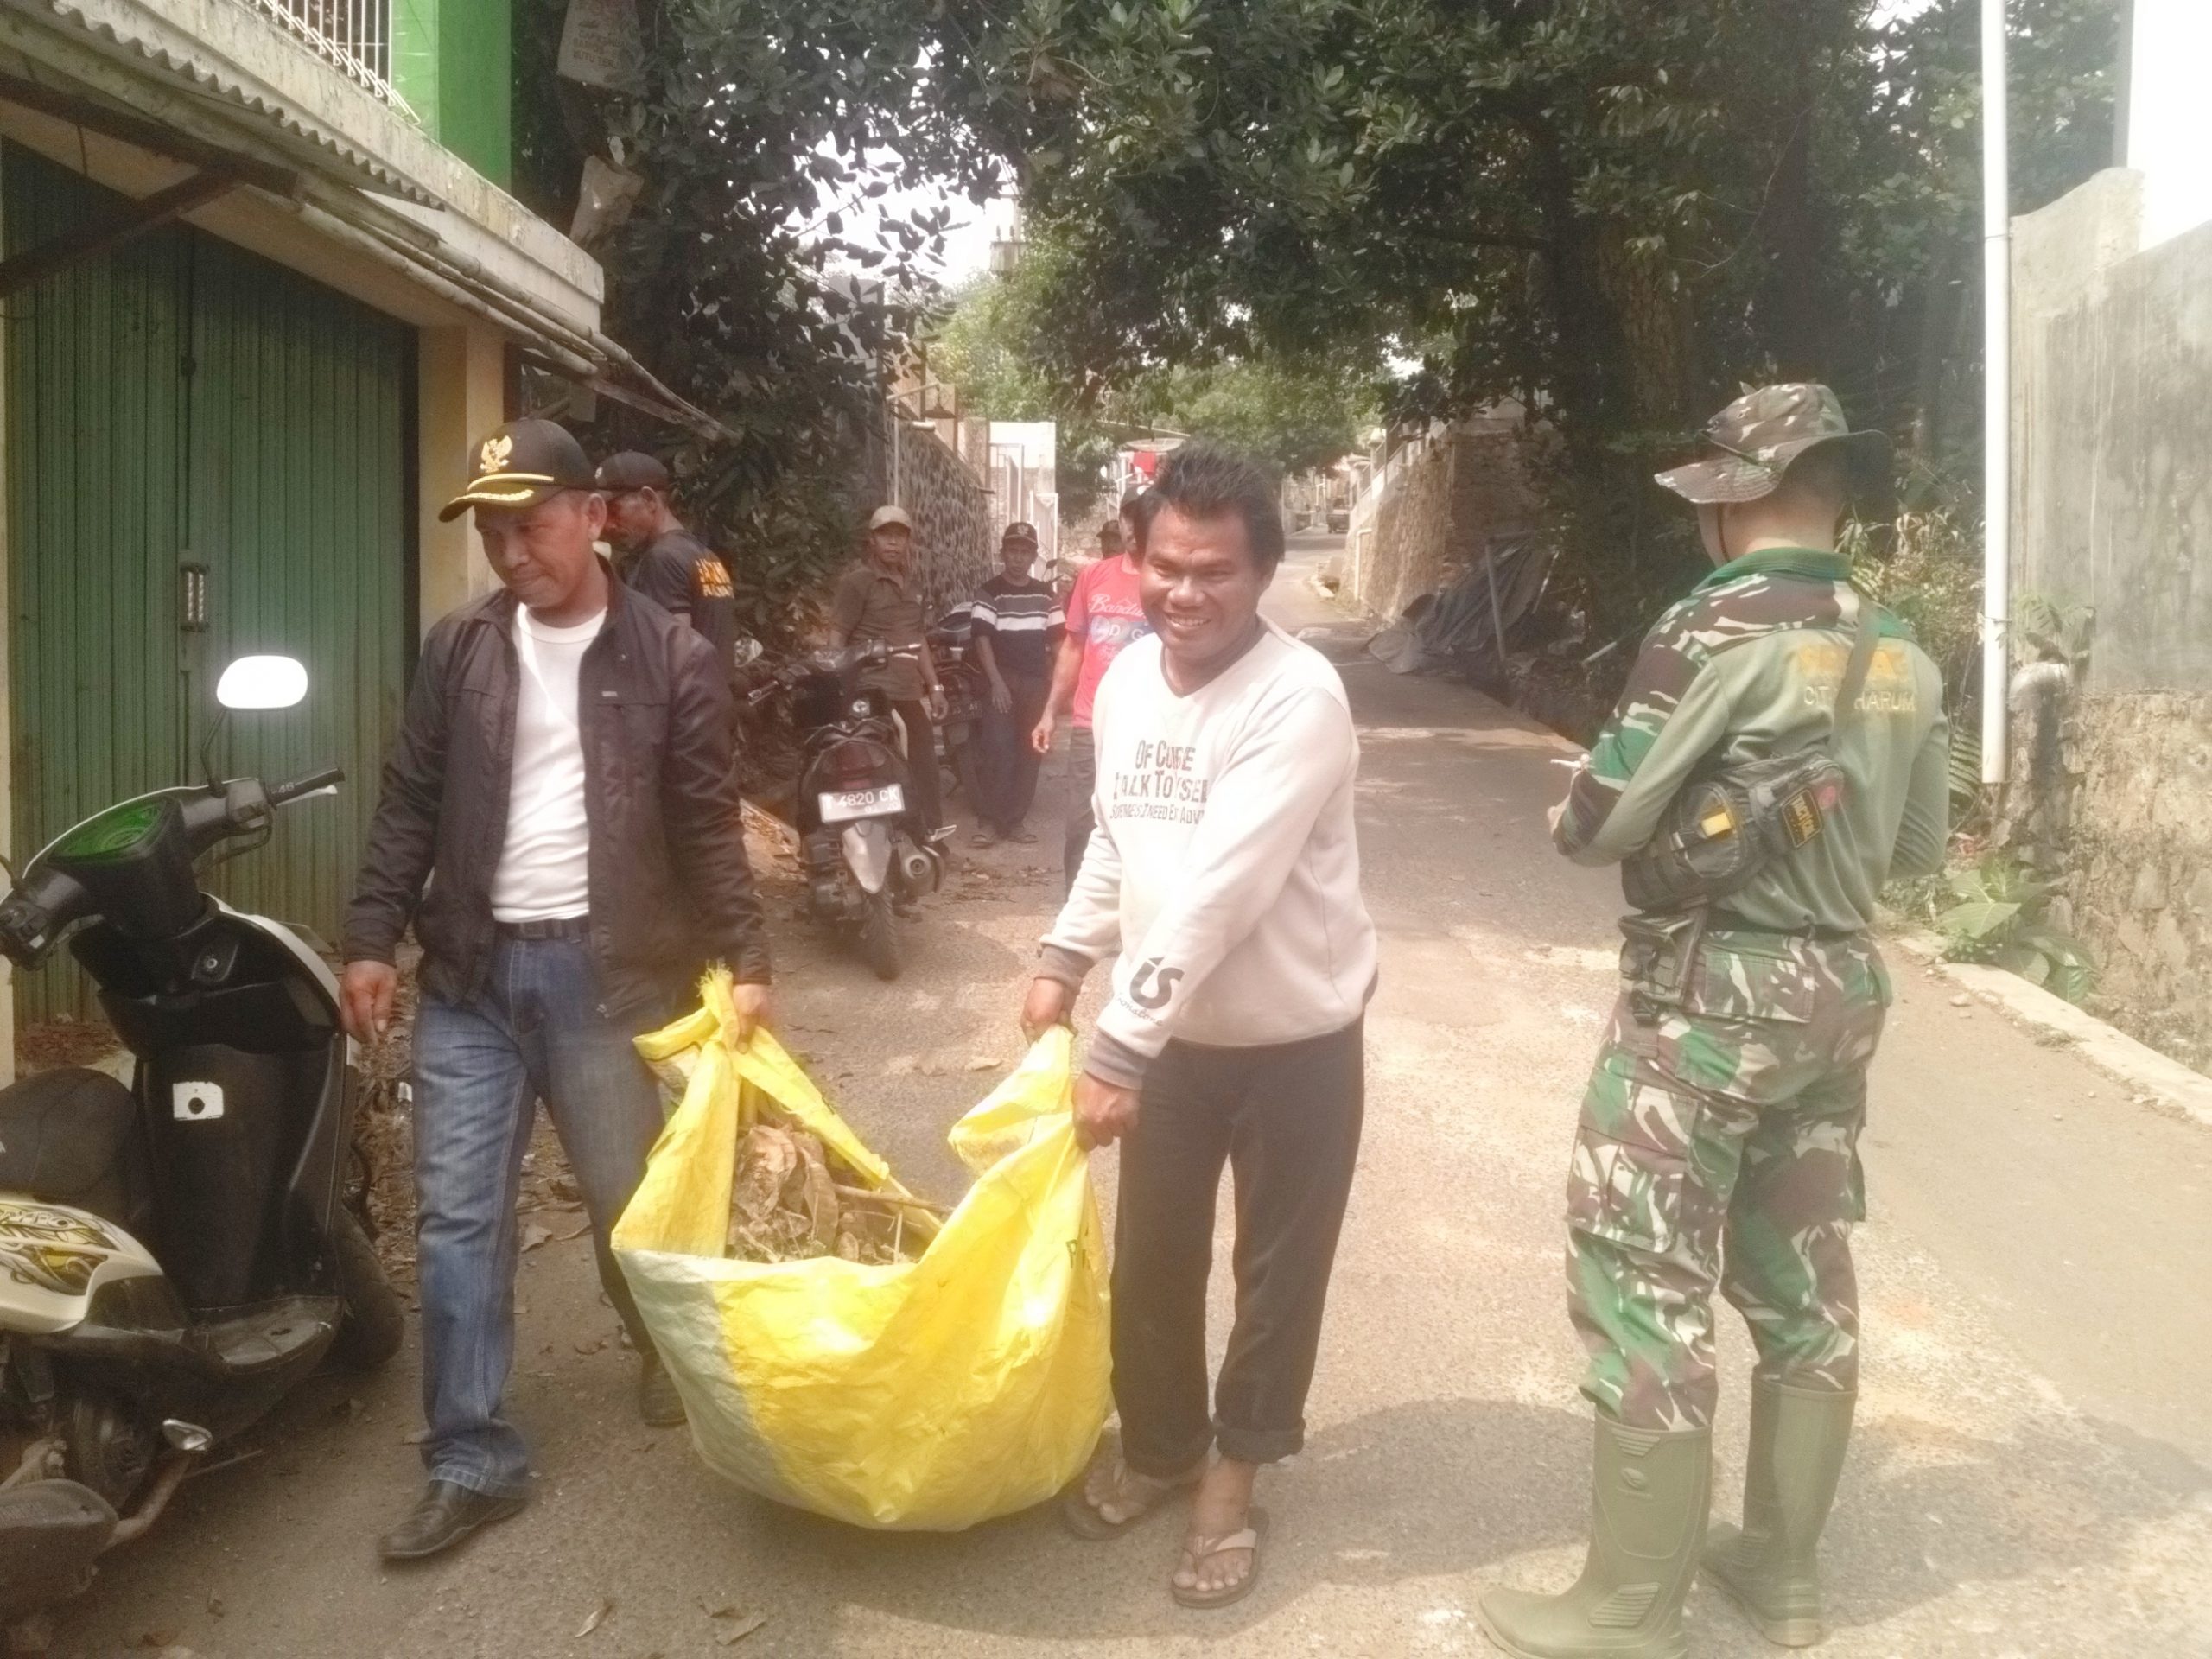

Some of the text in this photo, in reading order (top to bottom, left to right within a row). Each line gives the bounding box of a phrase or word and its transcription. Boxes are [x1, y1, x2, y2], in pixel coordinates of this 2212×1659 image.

[1135, 739, 1154, 769] OF
[1154, 769, 1174, 798] TO
[836, 792, 874, 807] 4820
